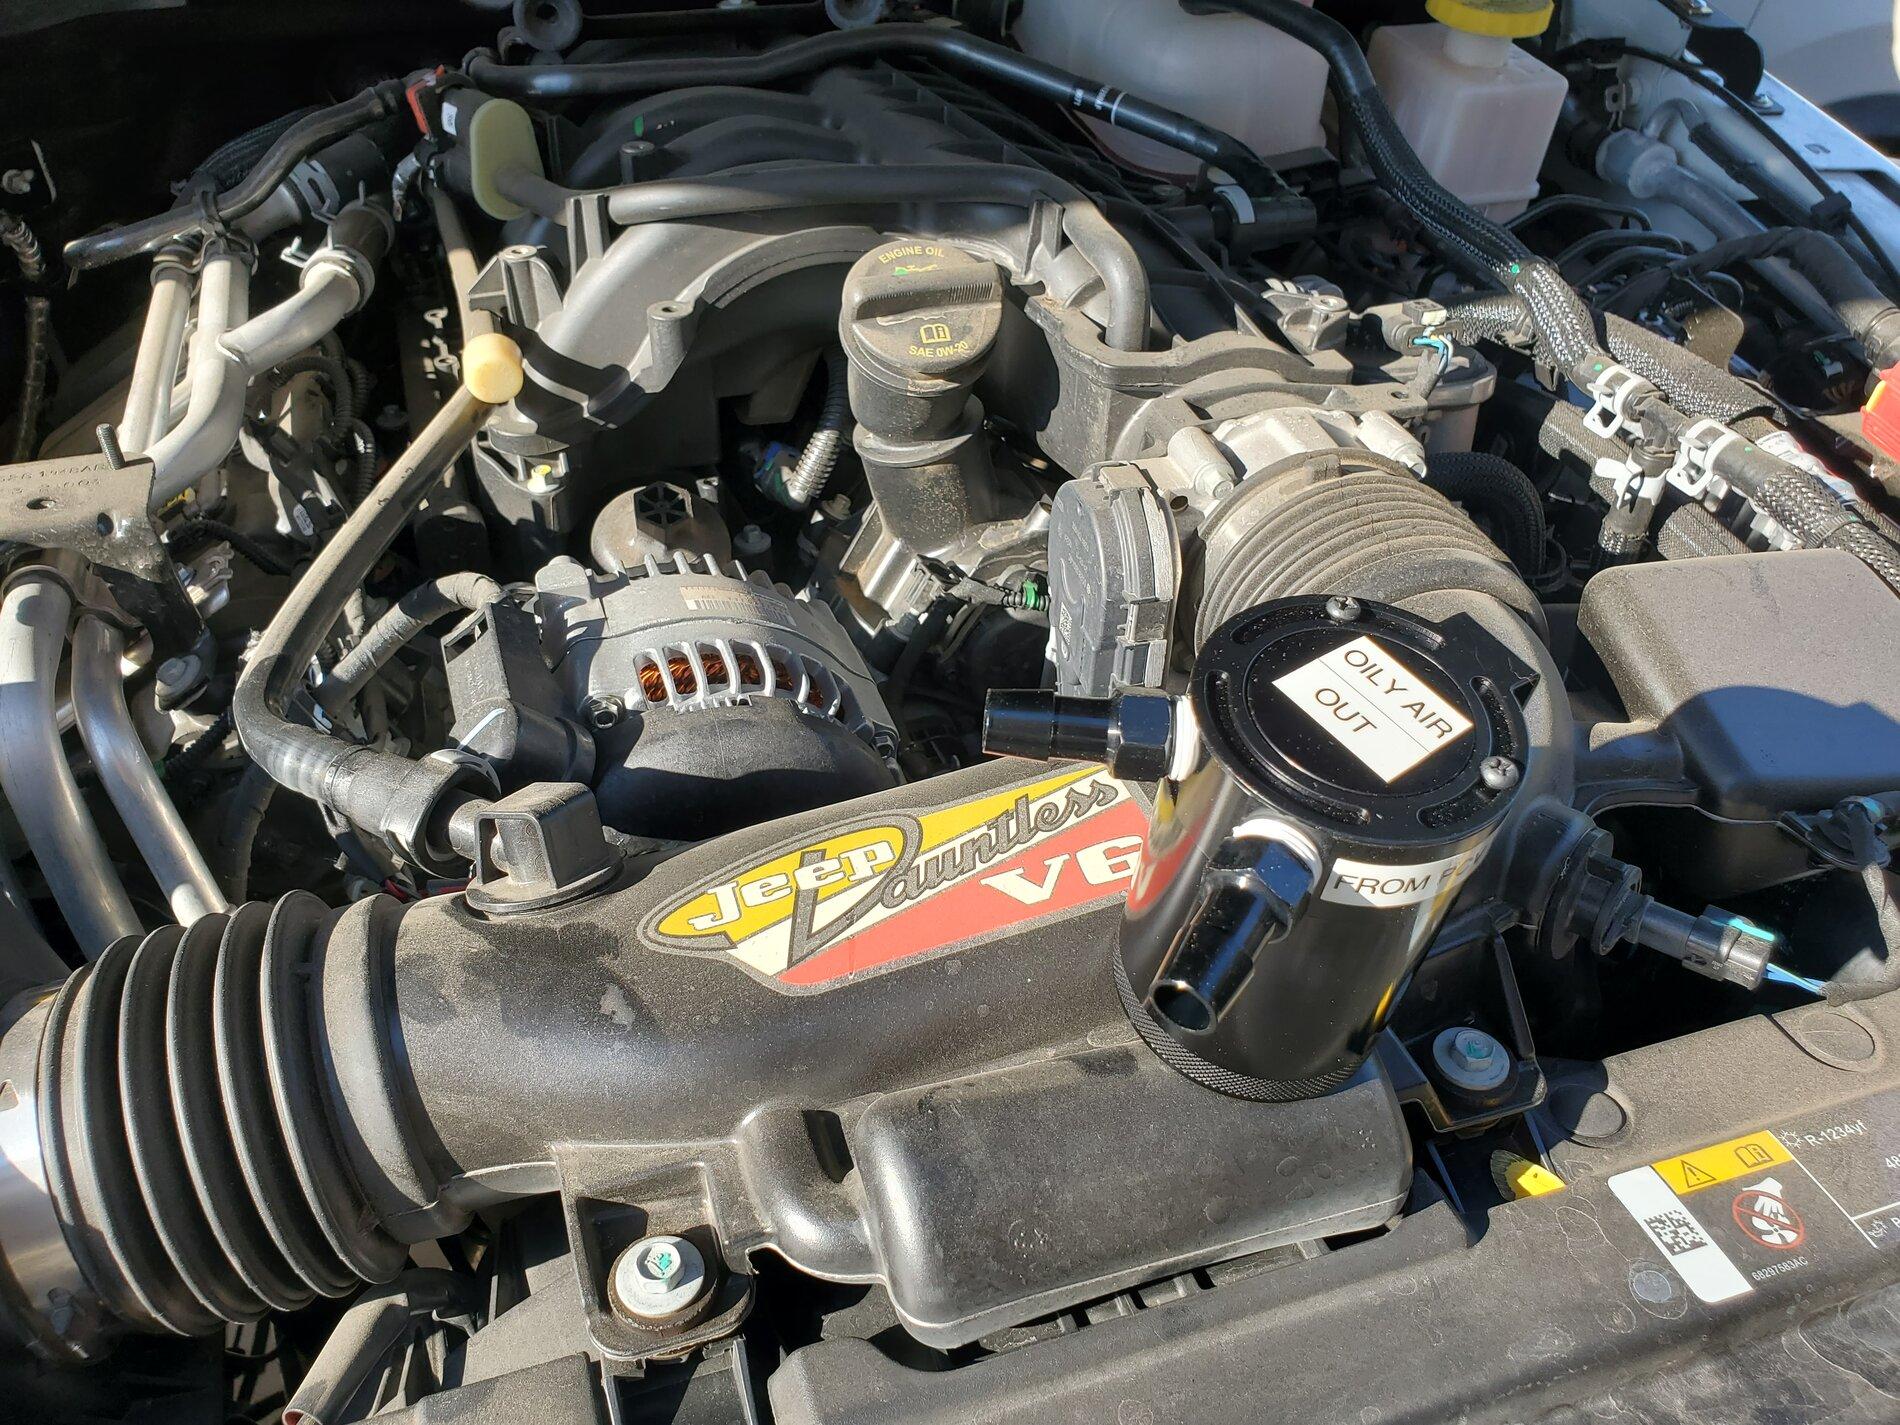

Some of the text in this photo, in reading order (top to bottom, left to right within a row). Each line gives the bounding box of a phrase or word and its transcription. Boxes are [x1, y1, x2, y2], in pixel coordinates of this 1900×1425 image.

[878, 246, 945, 264] ENGINE OIL
[909, 340, 968, 358] SAE 0W-20
[1315, 687, 1377, 733] OUT
[1343, 649, 1453, 739] OILY AIR
[648, 778, 1119, 970] Dauntless
[688, 839, 897, 931] Jeep
[980, 834, 1144, 905] V6
[1332, 874, 1431, 895] FROM
[1804, 1119, 1868, 1147] R-1234yf
